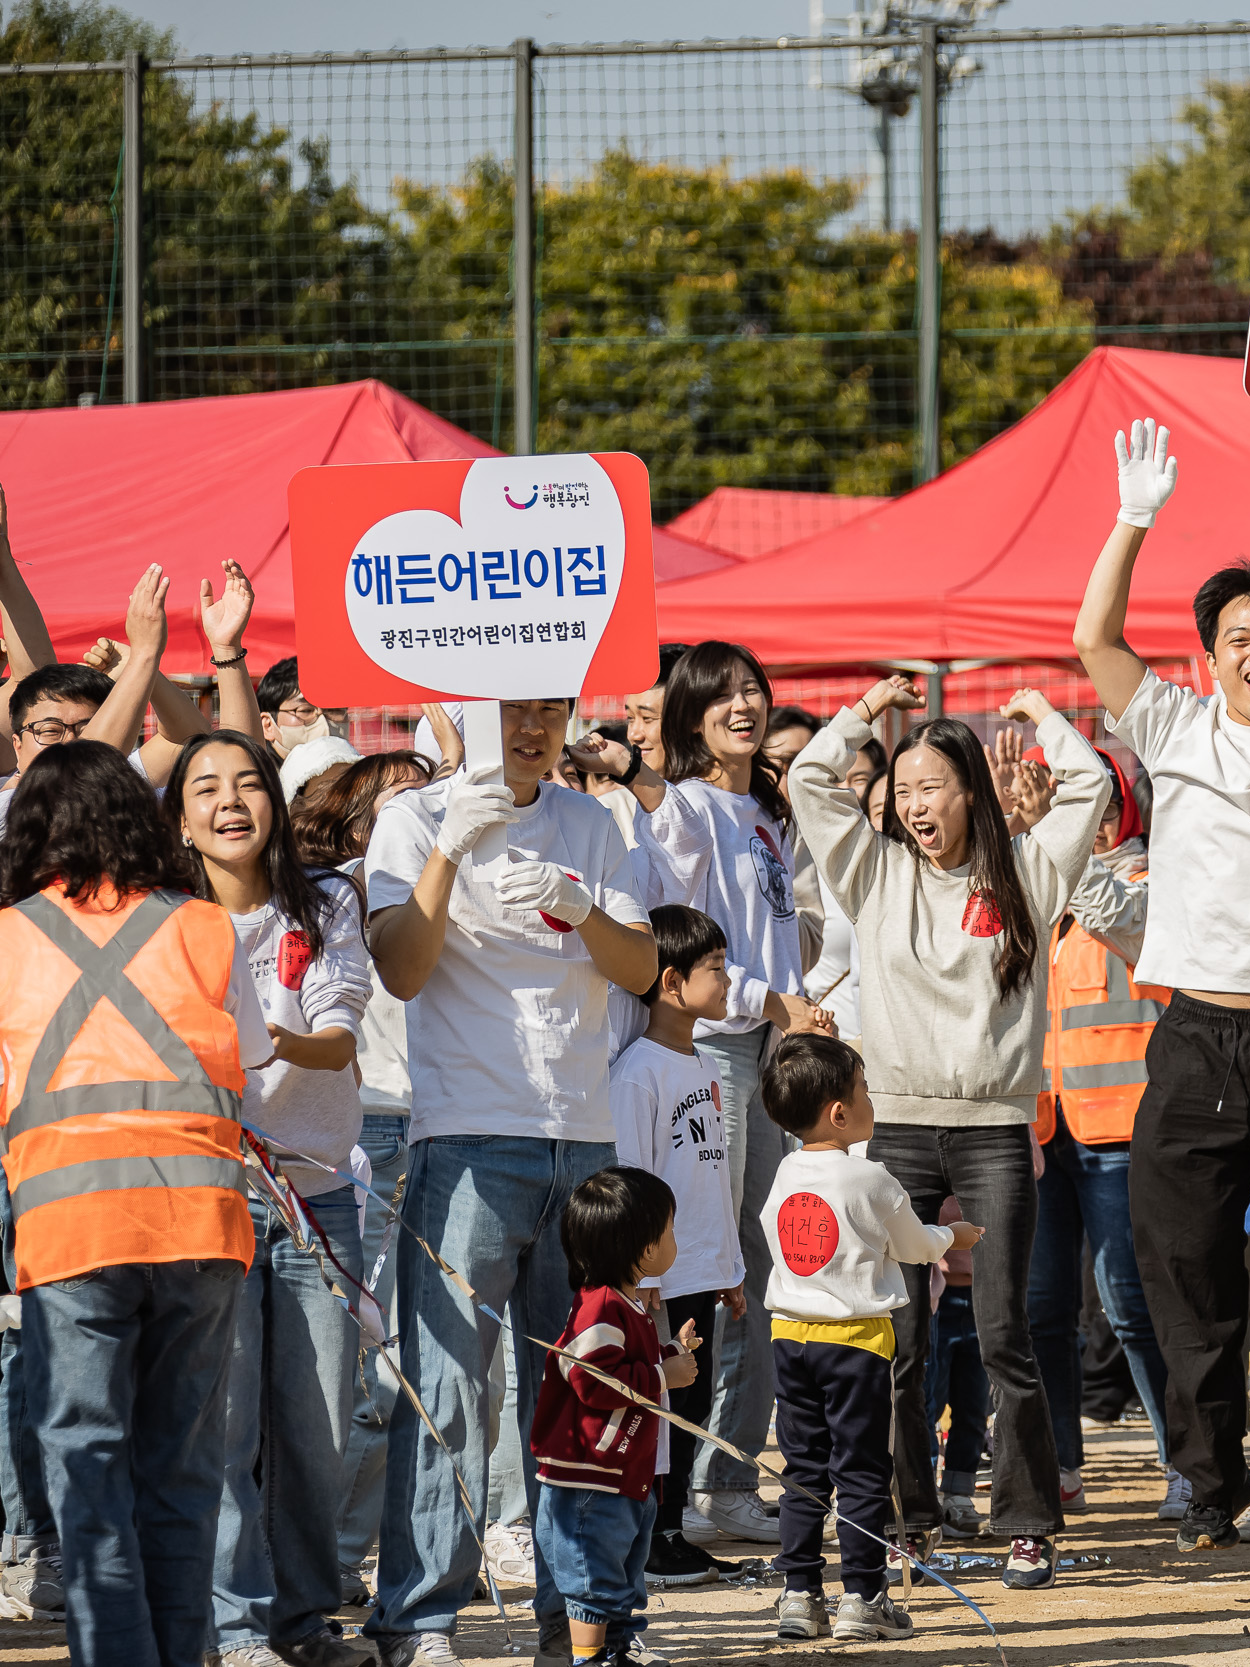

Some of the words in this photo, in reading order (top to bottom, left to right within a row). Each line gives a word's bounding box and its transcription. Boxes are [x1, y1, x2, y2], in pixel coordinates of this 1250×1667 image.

[543, 491, 590, 509] 행복광진
[351, 545, 607, 605] 해든어린이집
[380, 620, 587, 650] 광진구민간어린이집연합회
[671, 1088, 714, 1128] SINGLEB
[779, 1215, 831, 1250] 서건후
[617, 1436, 630, 1454] NEW
[627, 1414, 643, 1437] GOALS
